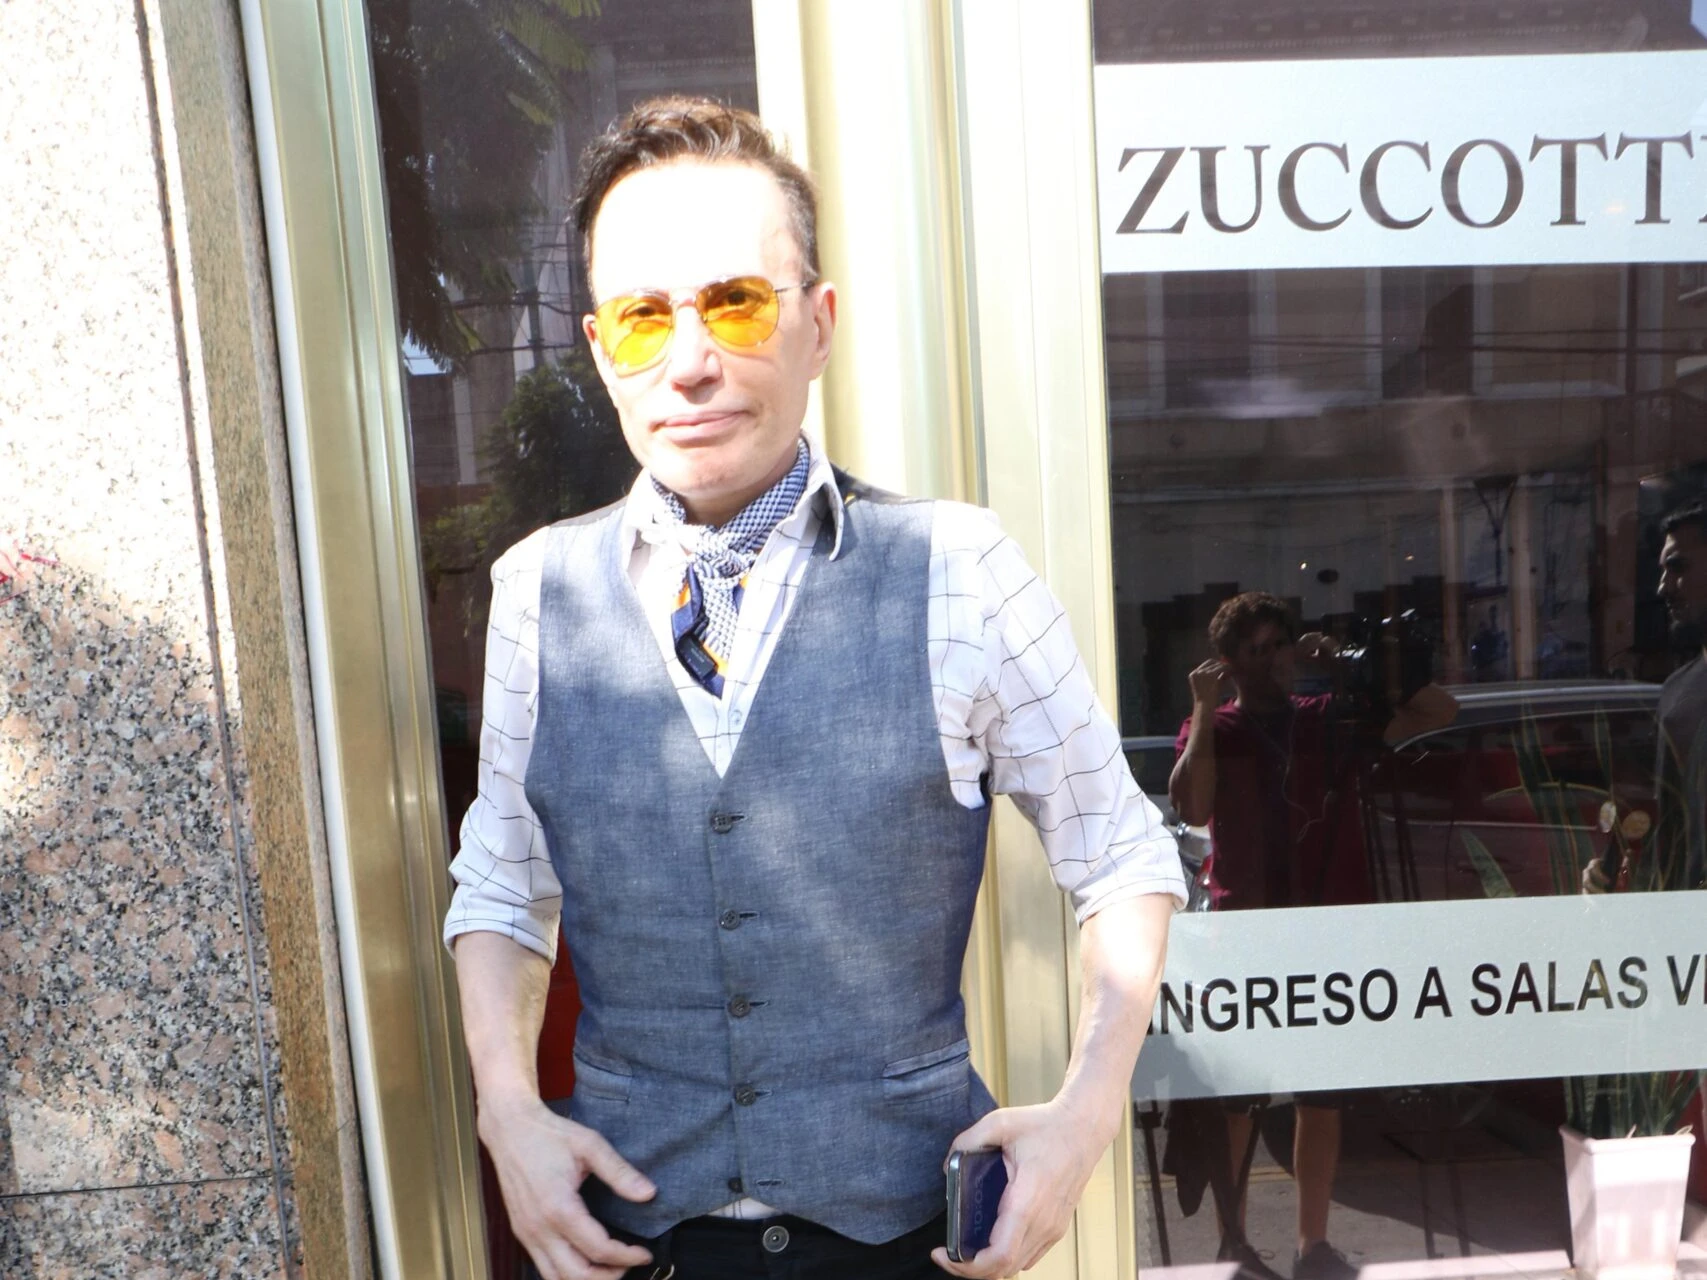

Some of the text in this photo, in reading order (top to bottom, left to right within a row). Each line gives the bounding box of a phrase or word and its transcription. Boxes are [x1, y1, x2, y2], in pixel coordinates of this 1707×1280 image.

[1115, 131, 1707, 235] ZUCCOTT
[1147, 954, 1707, 1036] NGRESO A SALAS V
